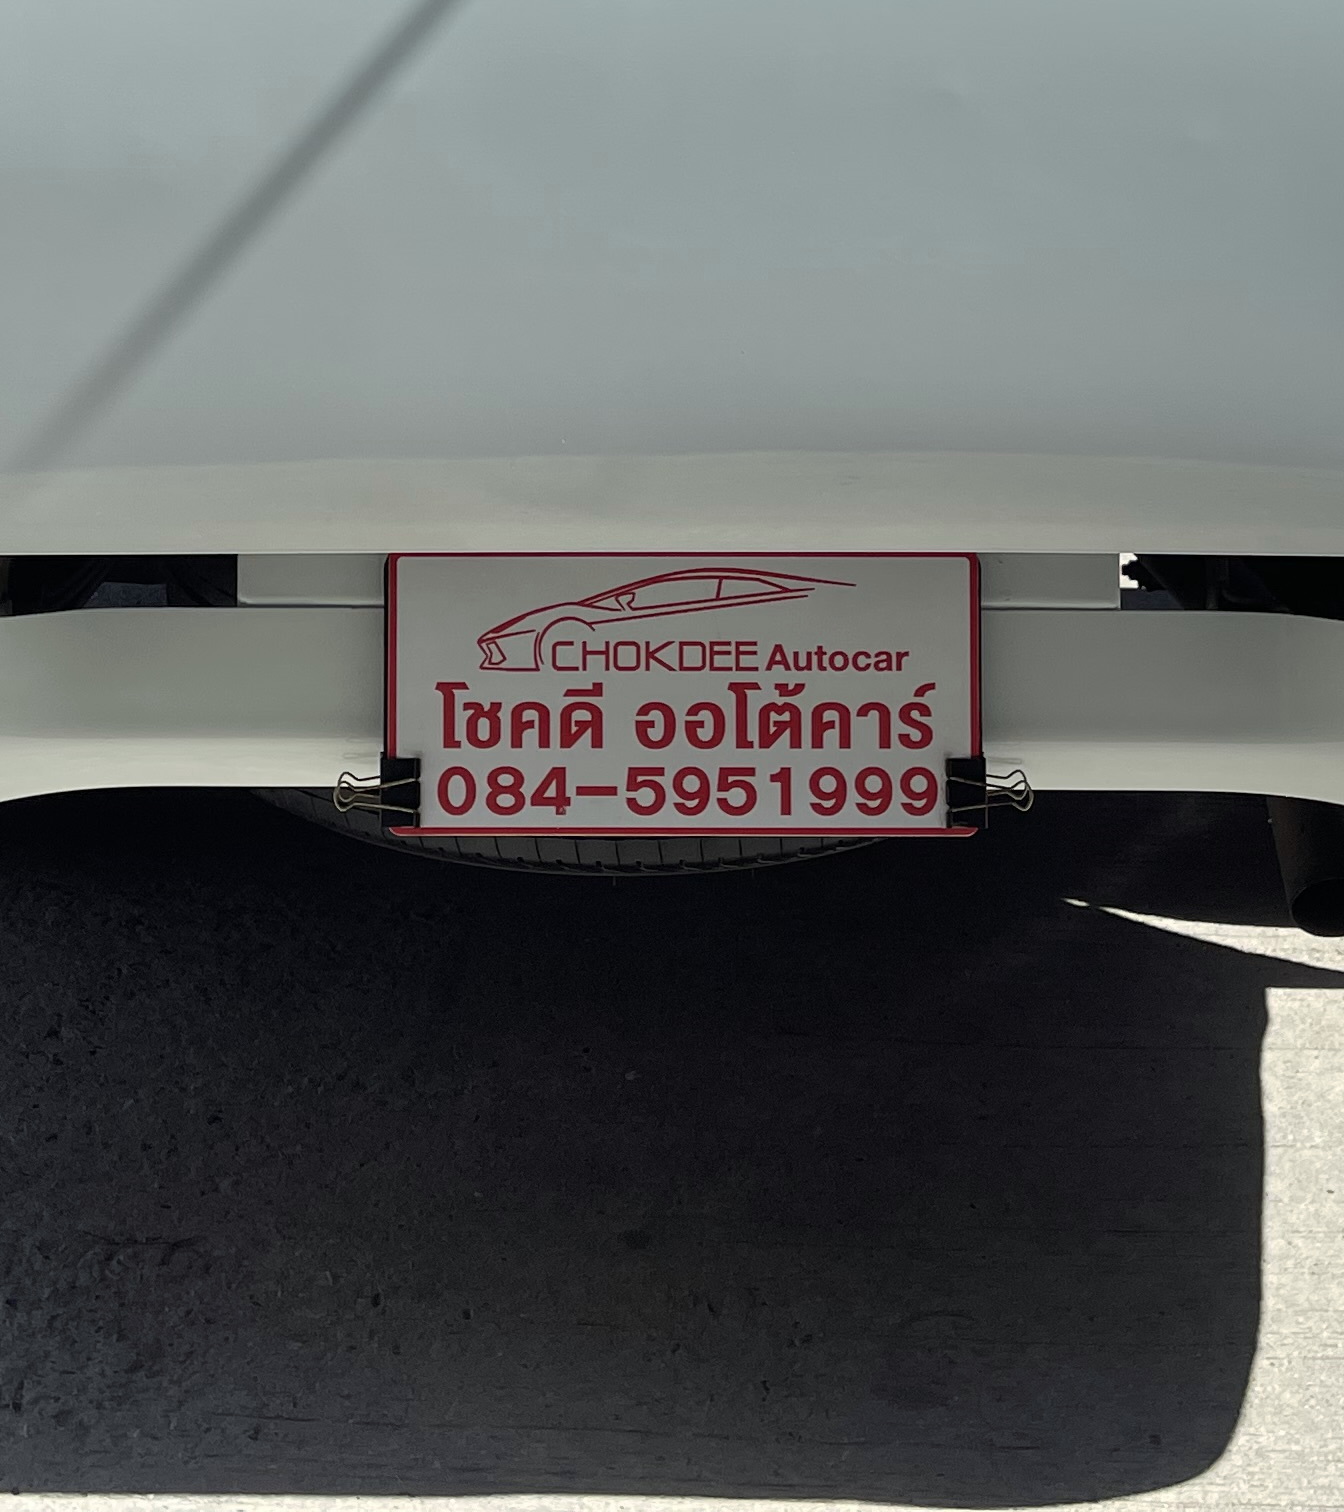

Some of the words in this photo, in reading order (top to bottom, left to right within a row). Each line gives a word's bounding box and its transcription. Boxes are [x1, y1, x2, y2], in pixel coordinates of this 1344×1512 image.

[551, 640, 758, 672] CHOKDEE
[765, 643, 909, 672] Autocar
[435, 681, 604, 749] โชคดี
[634, 681, 937, 750] ออโต้คาร์
[436, 765, 939, 816] 084-5951999
